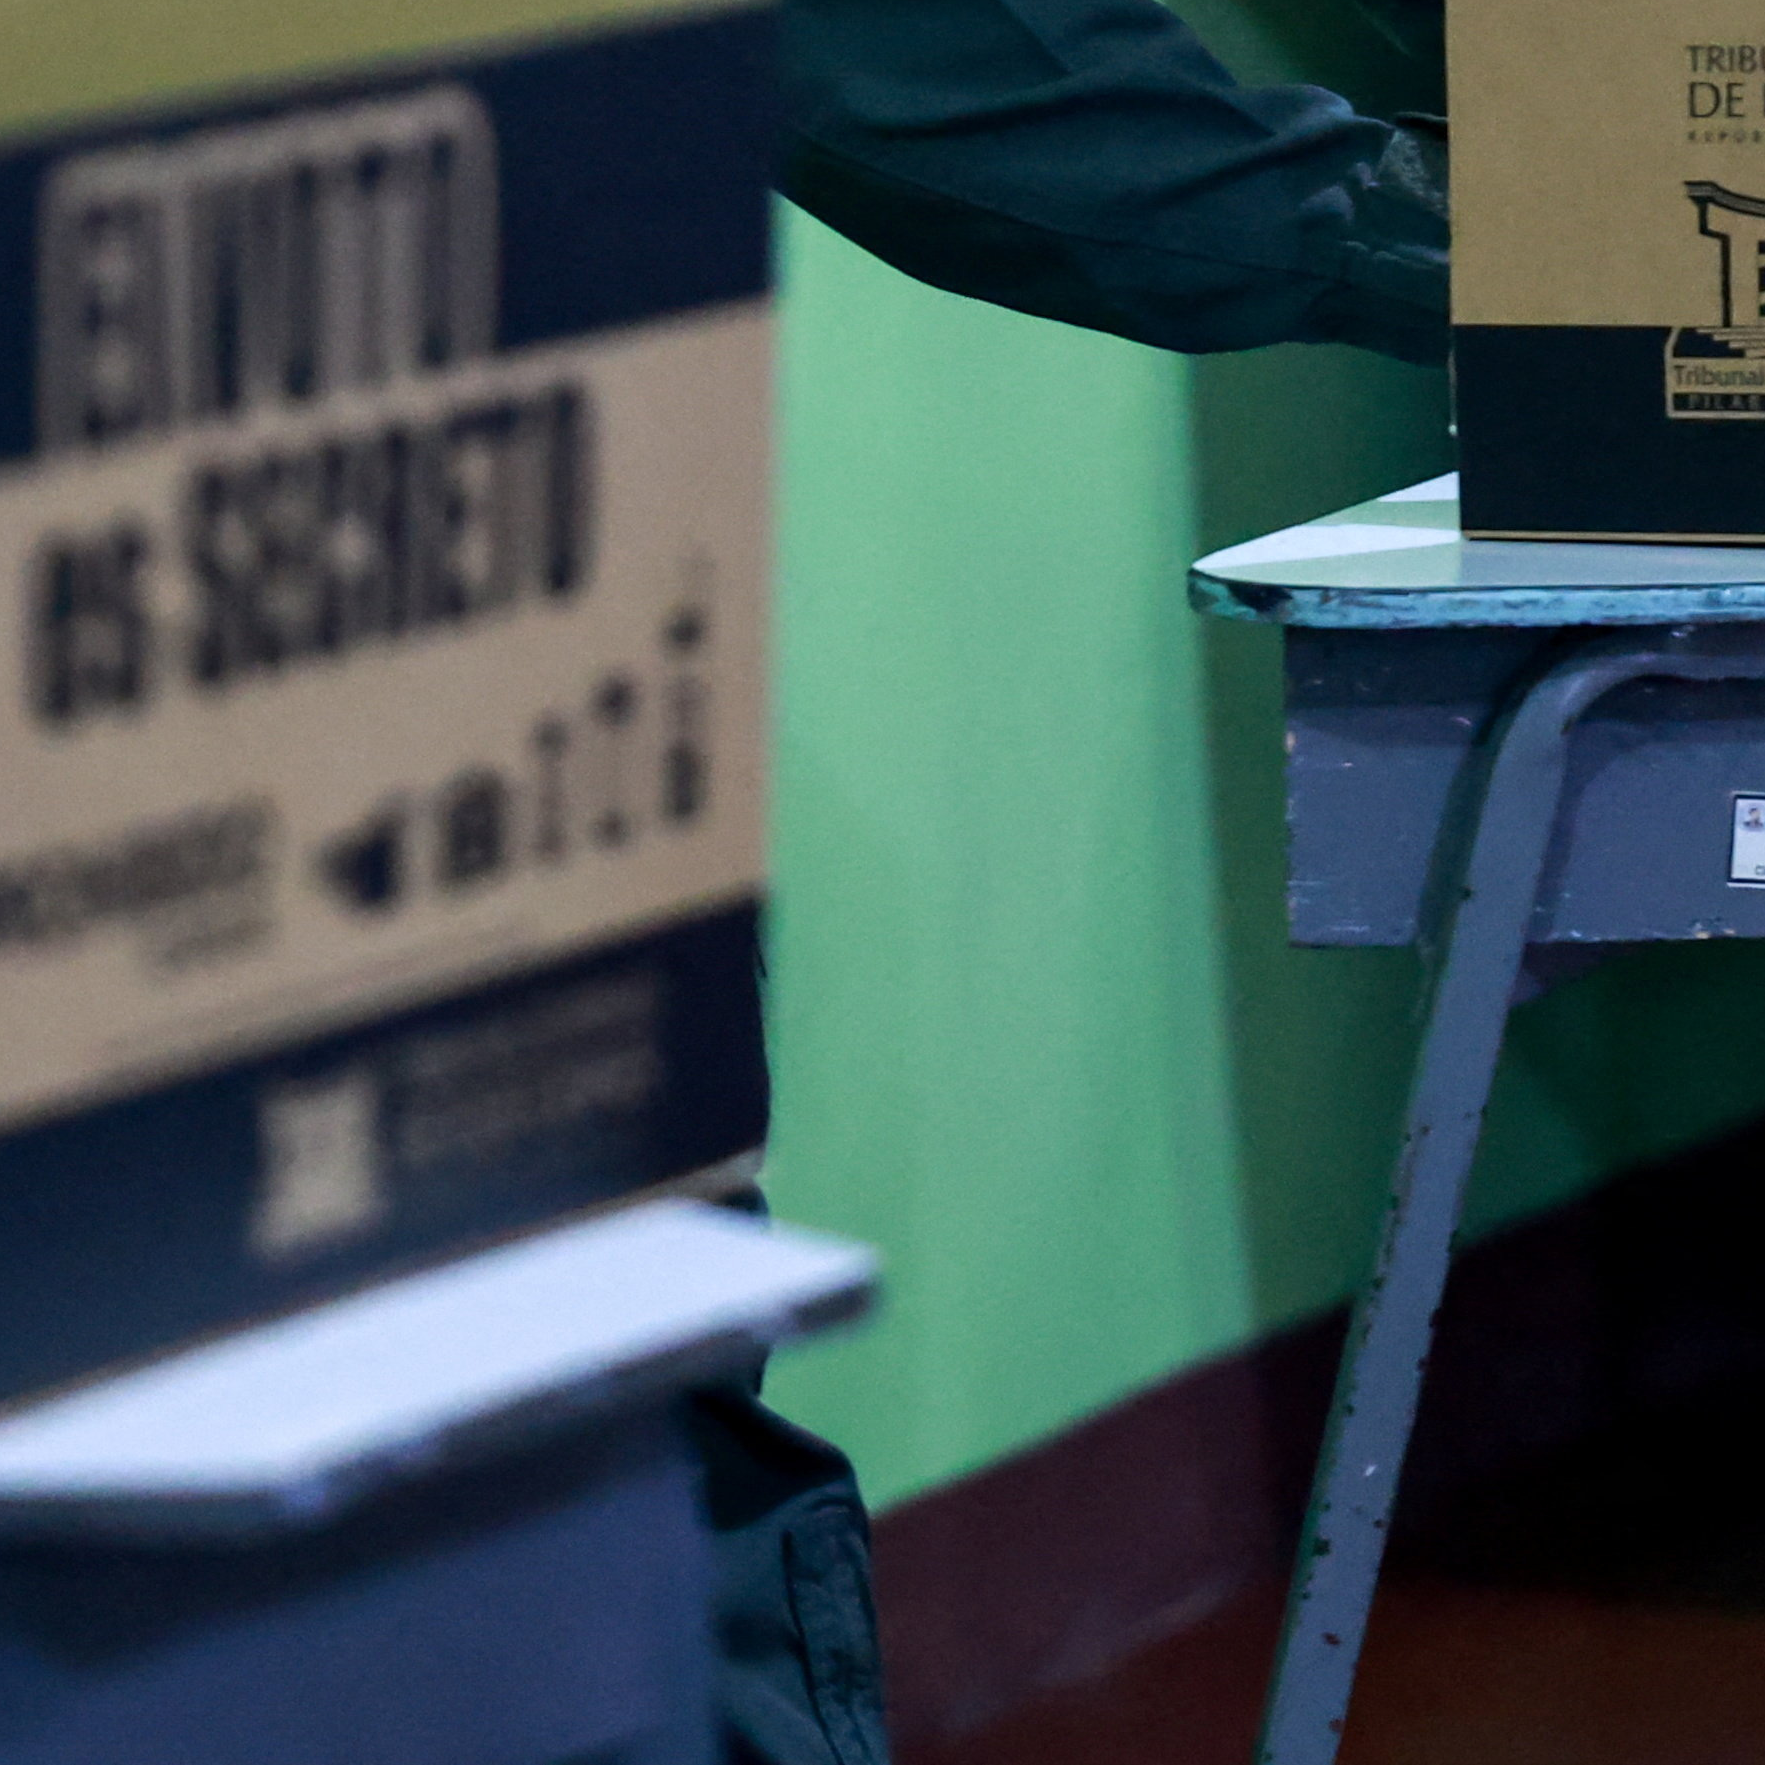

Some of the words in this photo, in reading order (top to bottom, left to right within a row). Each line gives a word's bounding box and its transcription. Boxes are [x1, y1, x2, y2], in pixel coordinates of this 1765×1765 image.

[1687, 81, 1746, 120] DE
[1673, 364, 1765, 388] Tribunal
[181, 374, 594, 696] SECRETO
